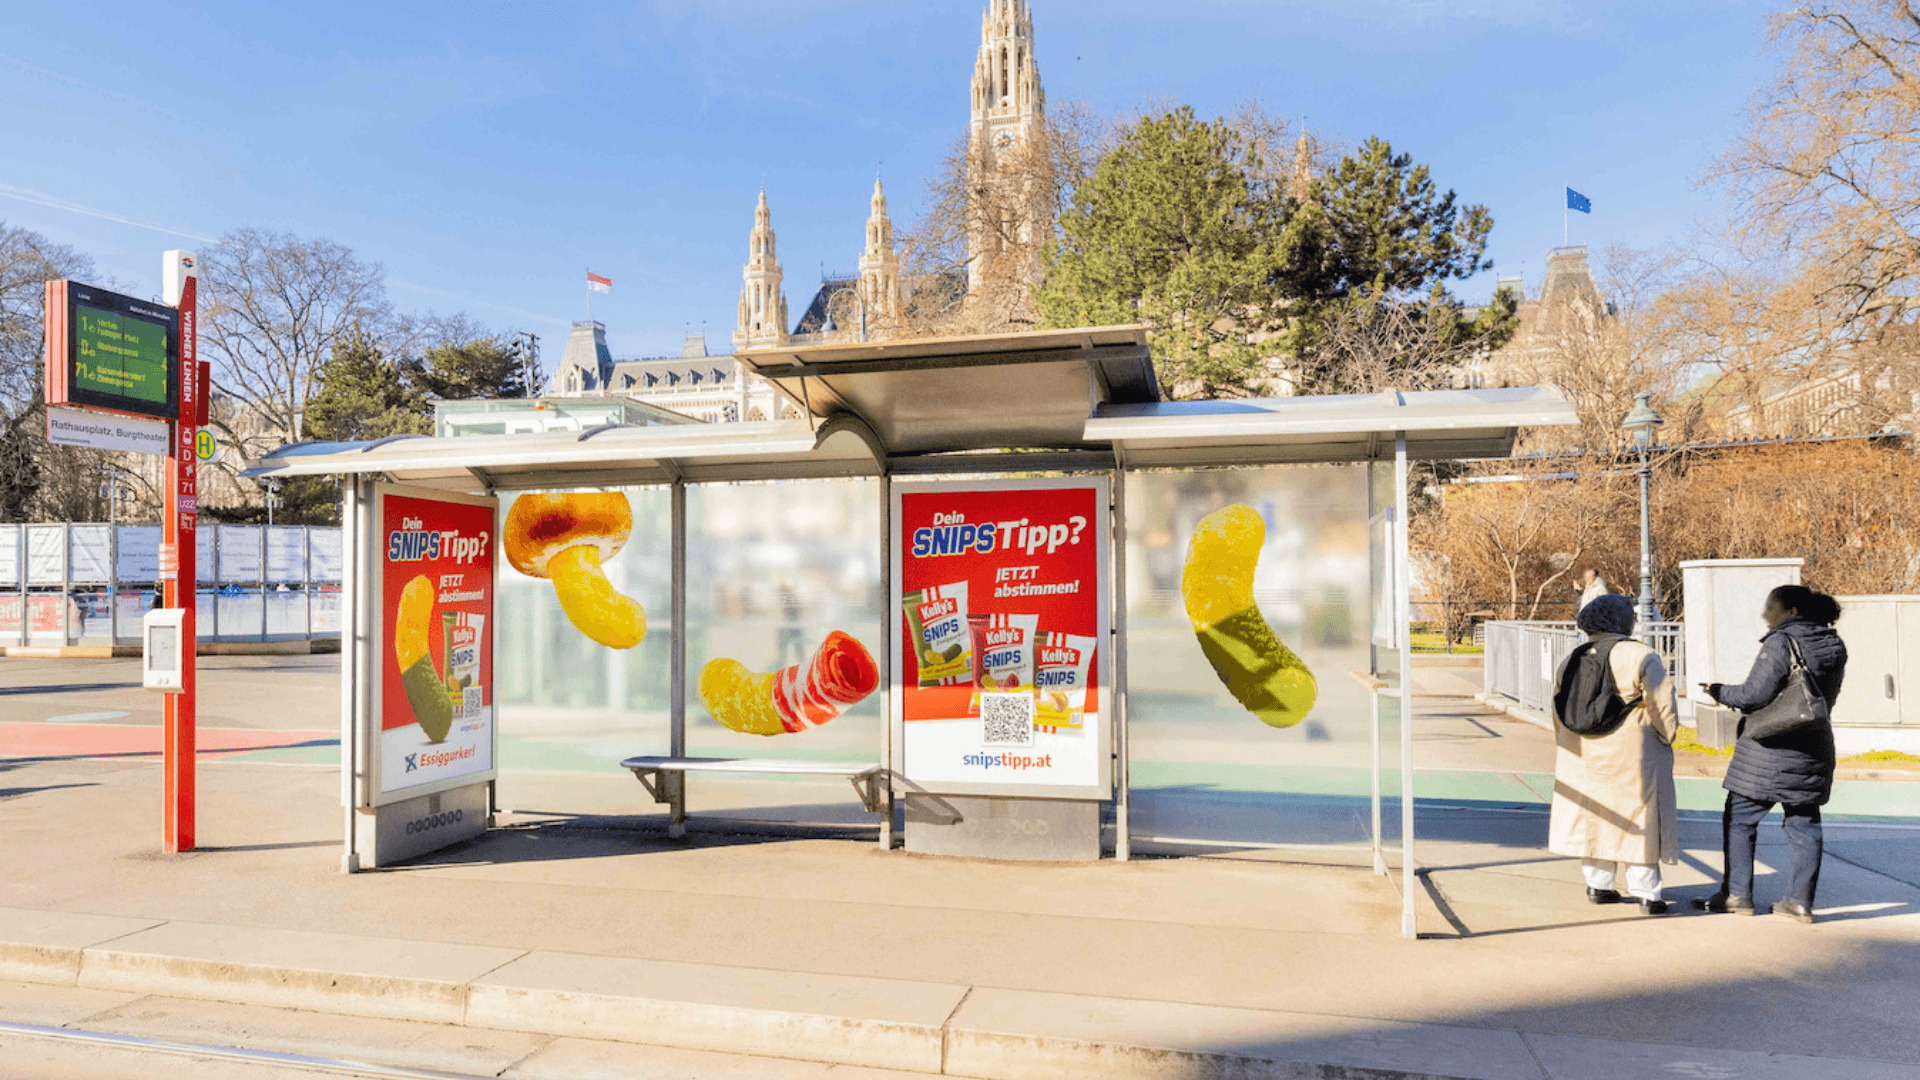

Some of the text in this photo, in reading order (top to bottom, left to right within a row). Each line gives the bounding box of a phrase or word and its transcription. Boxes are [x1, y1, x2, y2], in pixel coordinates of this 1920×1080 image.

[183, 310, 192, 402] WIENER LINIEN
[51, 419, 166, 443] Rathausplatz, Burgtheater
[183, 449, 192, 461] D
[182, 481, 193, 493] 71
[402, 516, 423, 530] Dein
[932, 510, 965, 526] Dein
[912, 516, 1087, 558] SNIPS Tipp?
[389, 529, 489, 564] SNIPS Tipp?
[439, 574, 464, 589] JETZT
[995, 566, 1039, 583] JETZT
[438, 588, 485, 603] abstimmen!
[994, 579, 1080, 598] abstimmen!
[920, 600, 954, 620] Kelly's
[923, 618, 960, 645] SNIPS
[985, 629, 1020, 645] Kelly's
[451, 649, 474, 668] SNIPS
[983, 650, 1022, 669] SNIPS
[1041, 649, 1077, 665] Kelly's
[1036, 671, 1076, 686] SNIPS
[962, 751, 1052, 770] snipstipp.at
